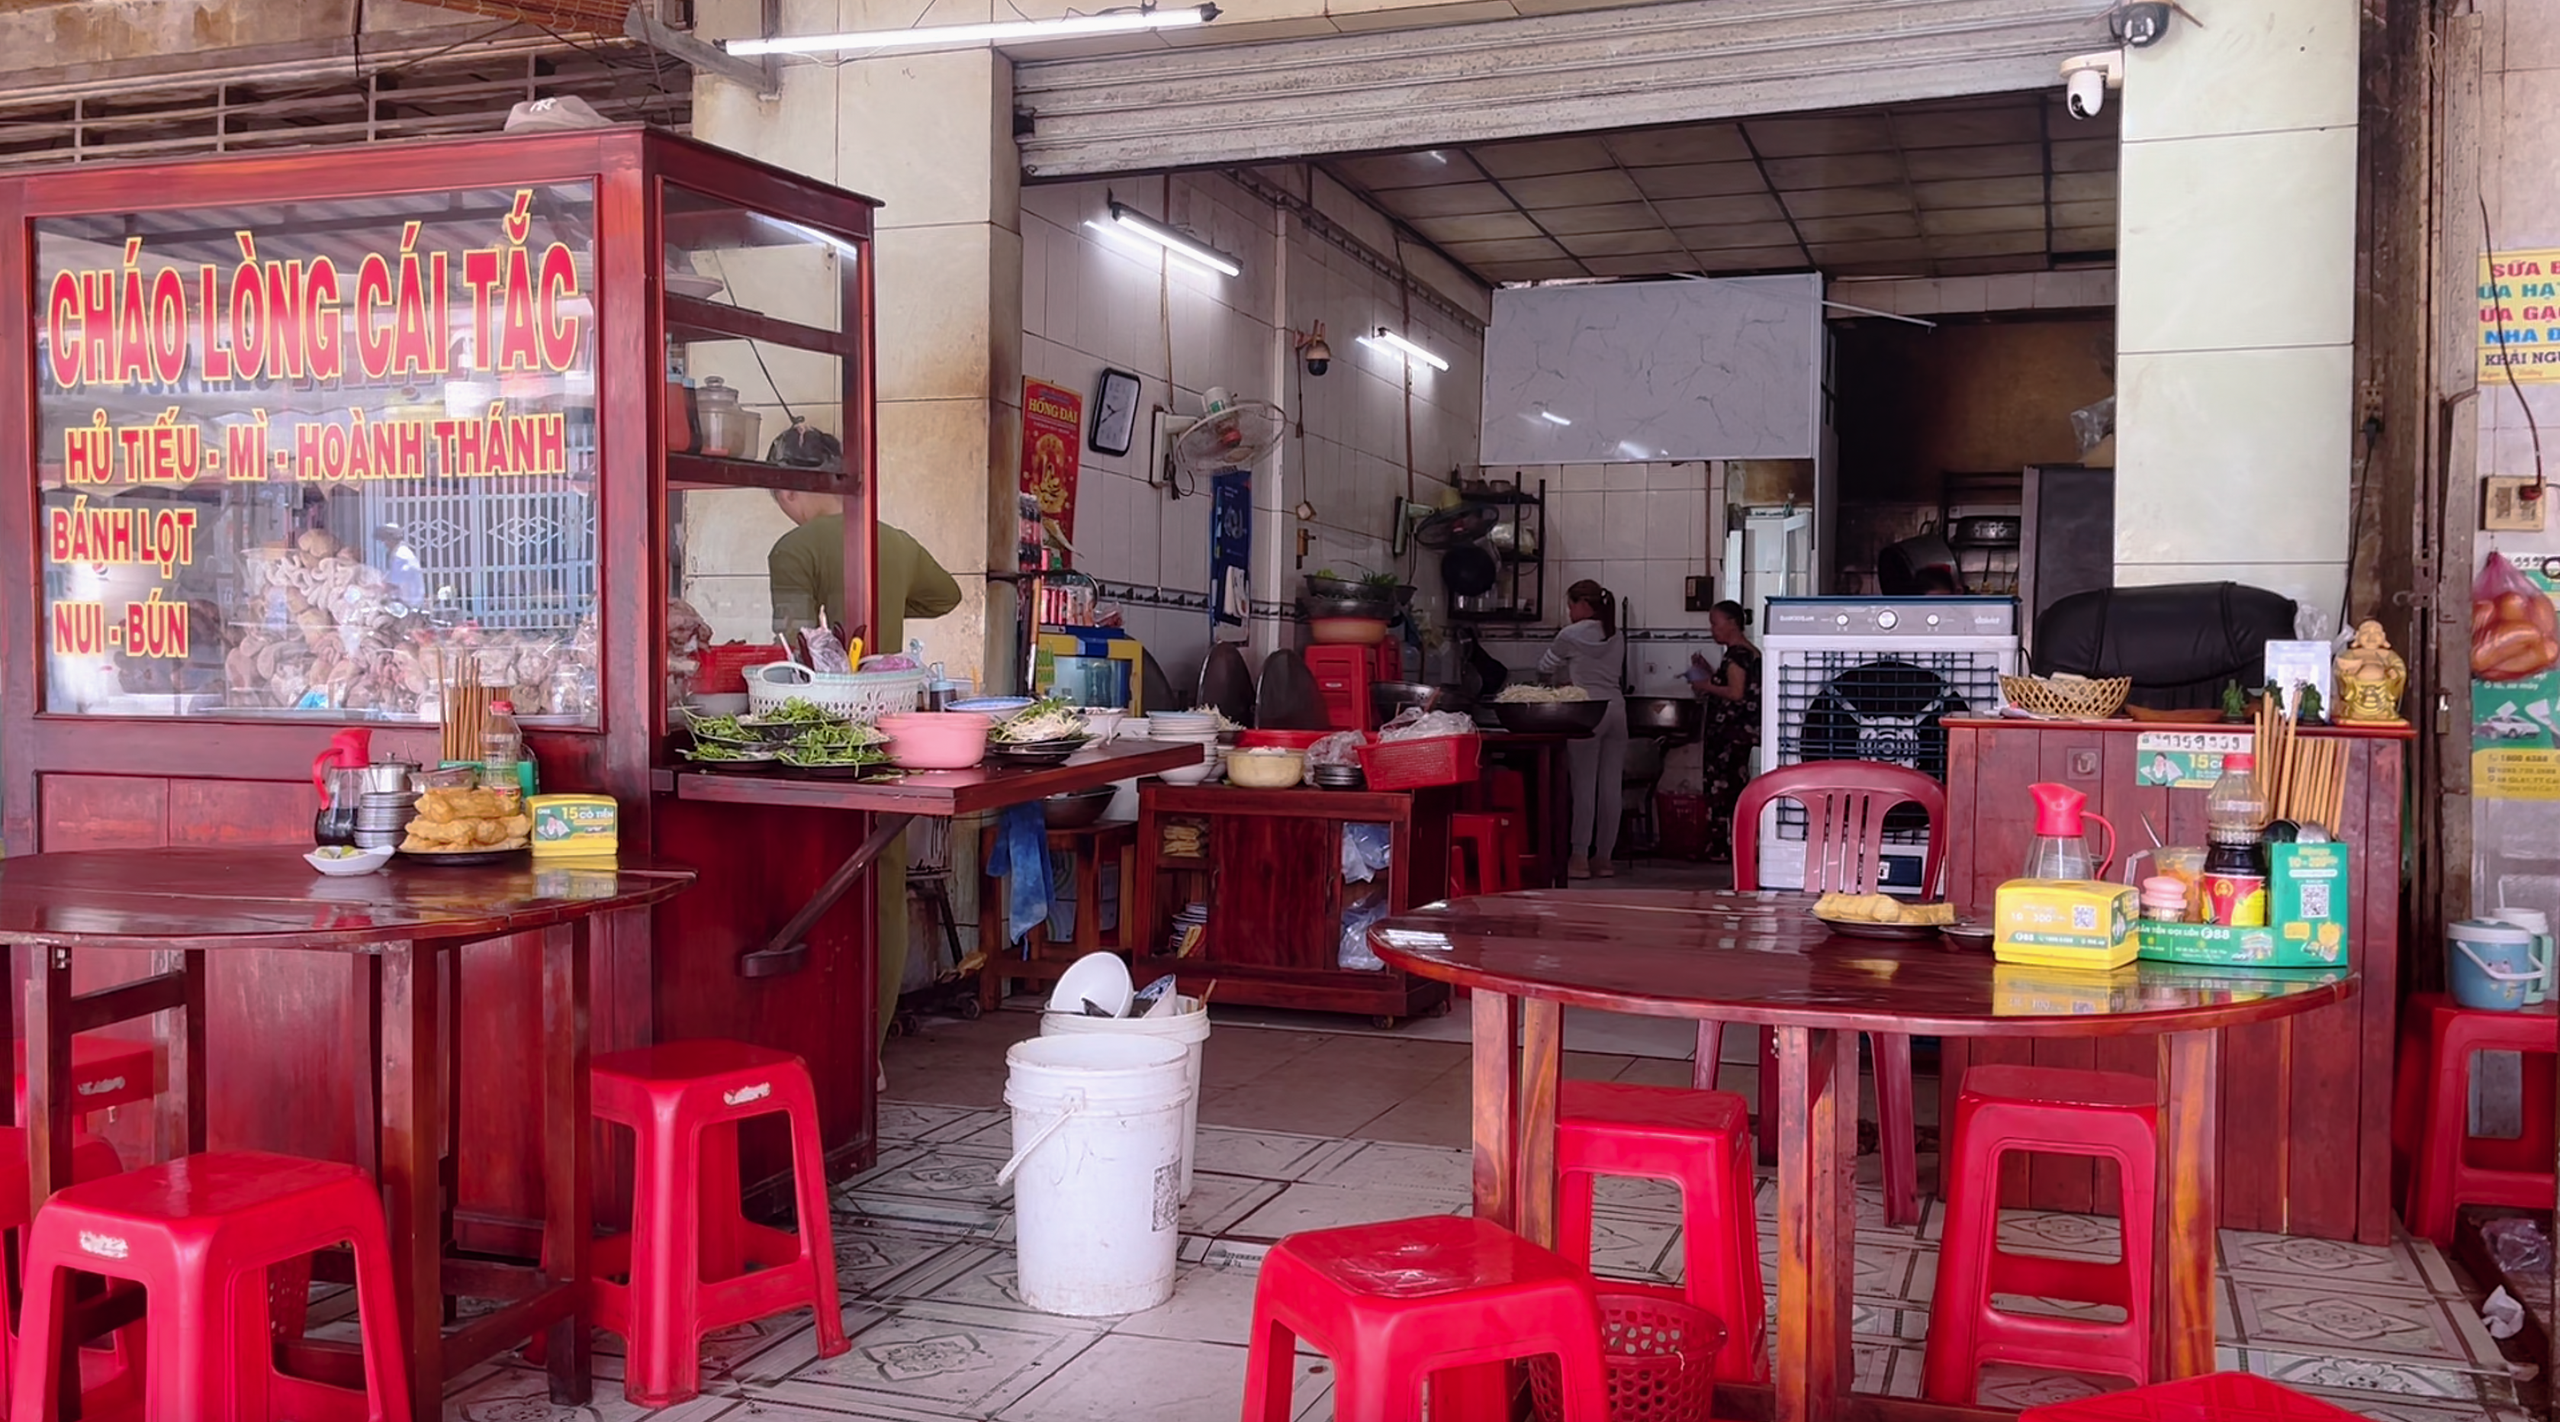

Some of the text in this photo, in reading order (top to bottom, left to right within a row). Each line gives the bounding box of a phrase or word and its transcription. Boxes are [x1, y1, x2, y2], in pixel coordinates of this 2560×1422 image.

[47, 189, 580, 388] CHÁO LÒNG CÁI TẮC
[2522, 281, 2560, 300] HẠ
[2523, 305, 2560, 323] GẠ
[2485, 328, 2539, 345] NHA
[2532, 351, 2560, 364] NG
[65, 407, 113, 484] HỦ
[120, 406, 200, 482] TIẾU
[227, 408, 268, 482] MÌ
[295, 407, 425, 481] HOÀNH
[431, 401, 567, 479] THÁNH
[50, 496, 197, 580] BÁNH LỌT
[52, 602, 103, 656] NUI
[126, 588, 190, 658] BÚN
[562, 806, 578, 820] 15
